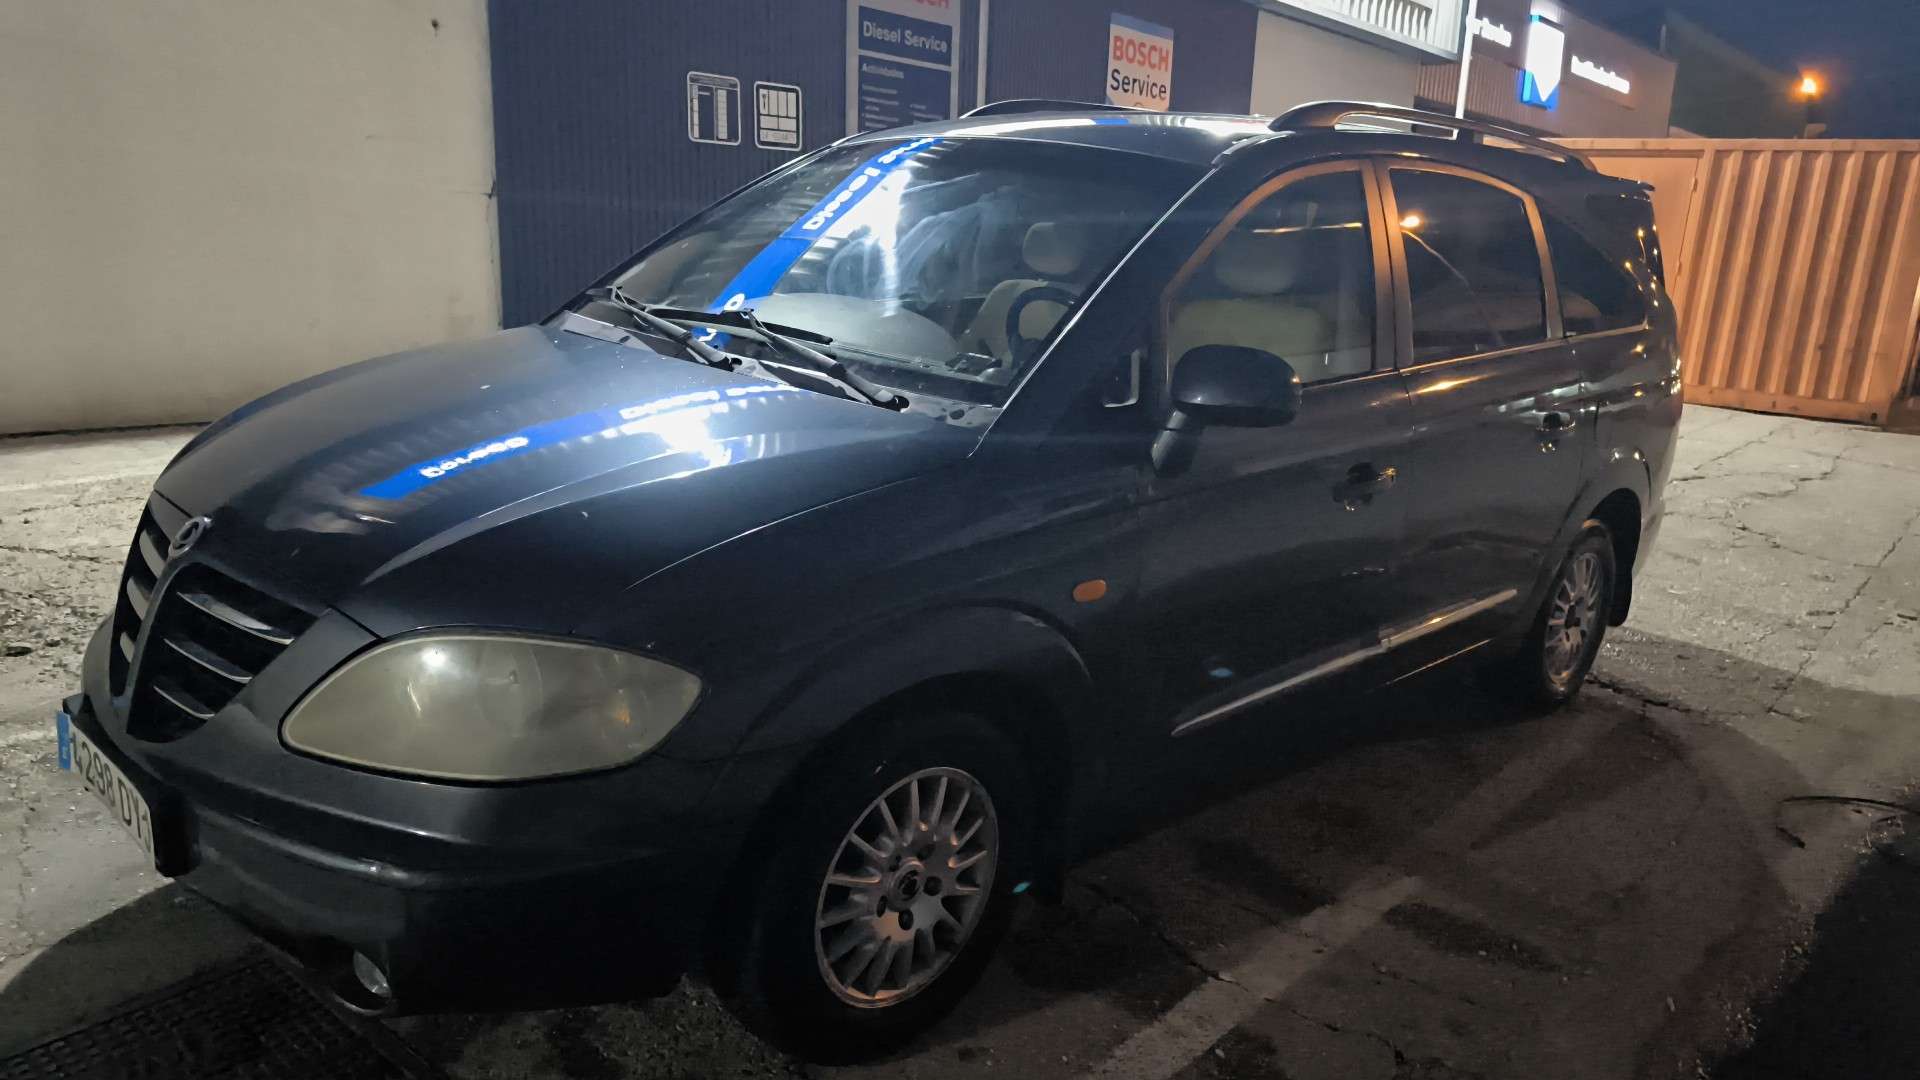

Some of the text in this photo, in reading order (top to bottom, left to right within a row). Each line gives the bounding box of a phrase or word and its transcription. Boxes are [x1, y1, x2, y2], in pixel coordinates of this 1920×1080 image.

[863, 20, 948, 53] Diesel Service
[1113, 35, 1169, 72] BOSCH
[1110, 68, 1167, 101] Service
